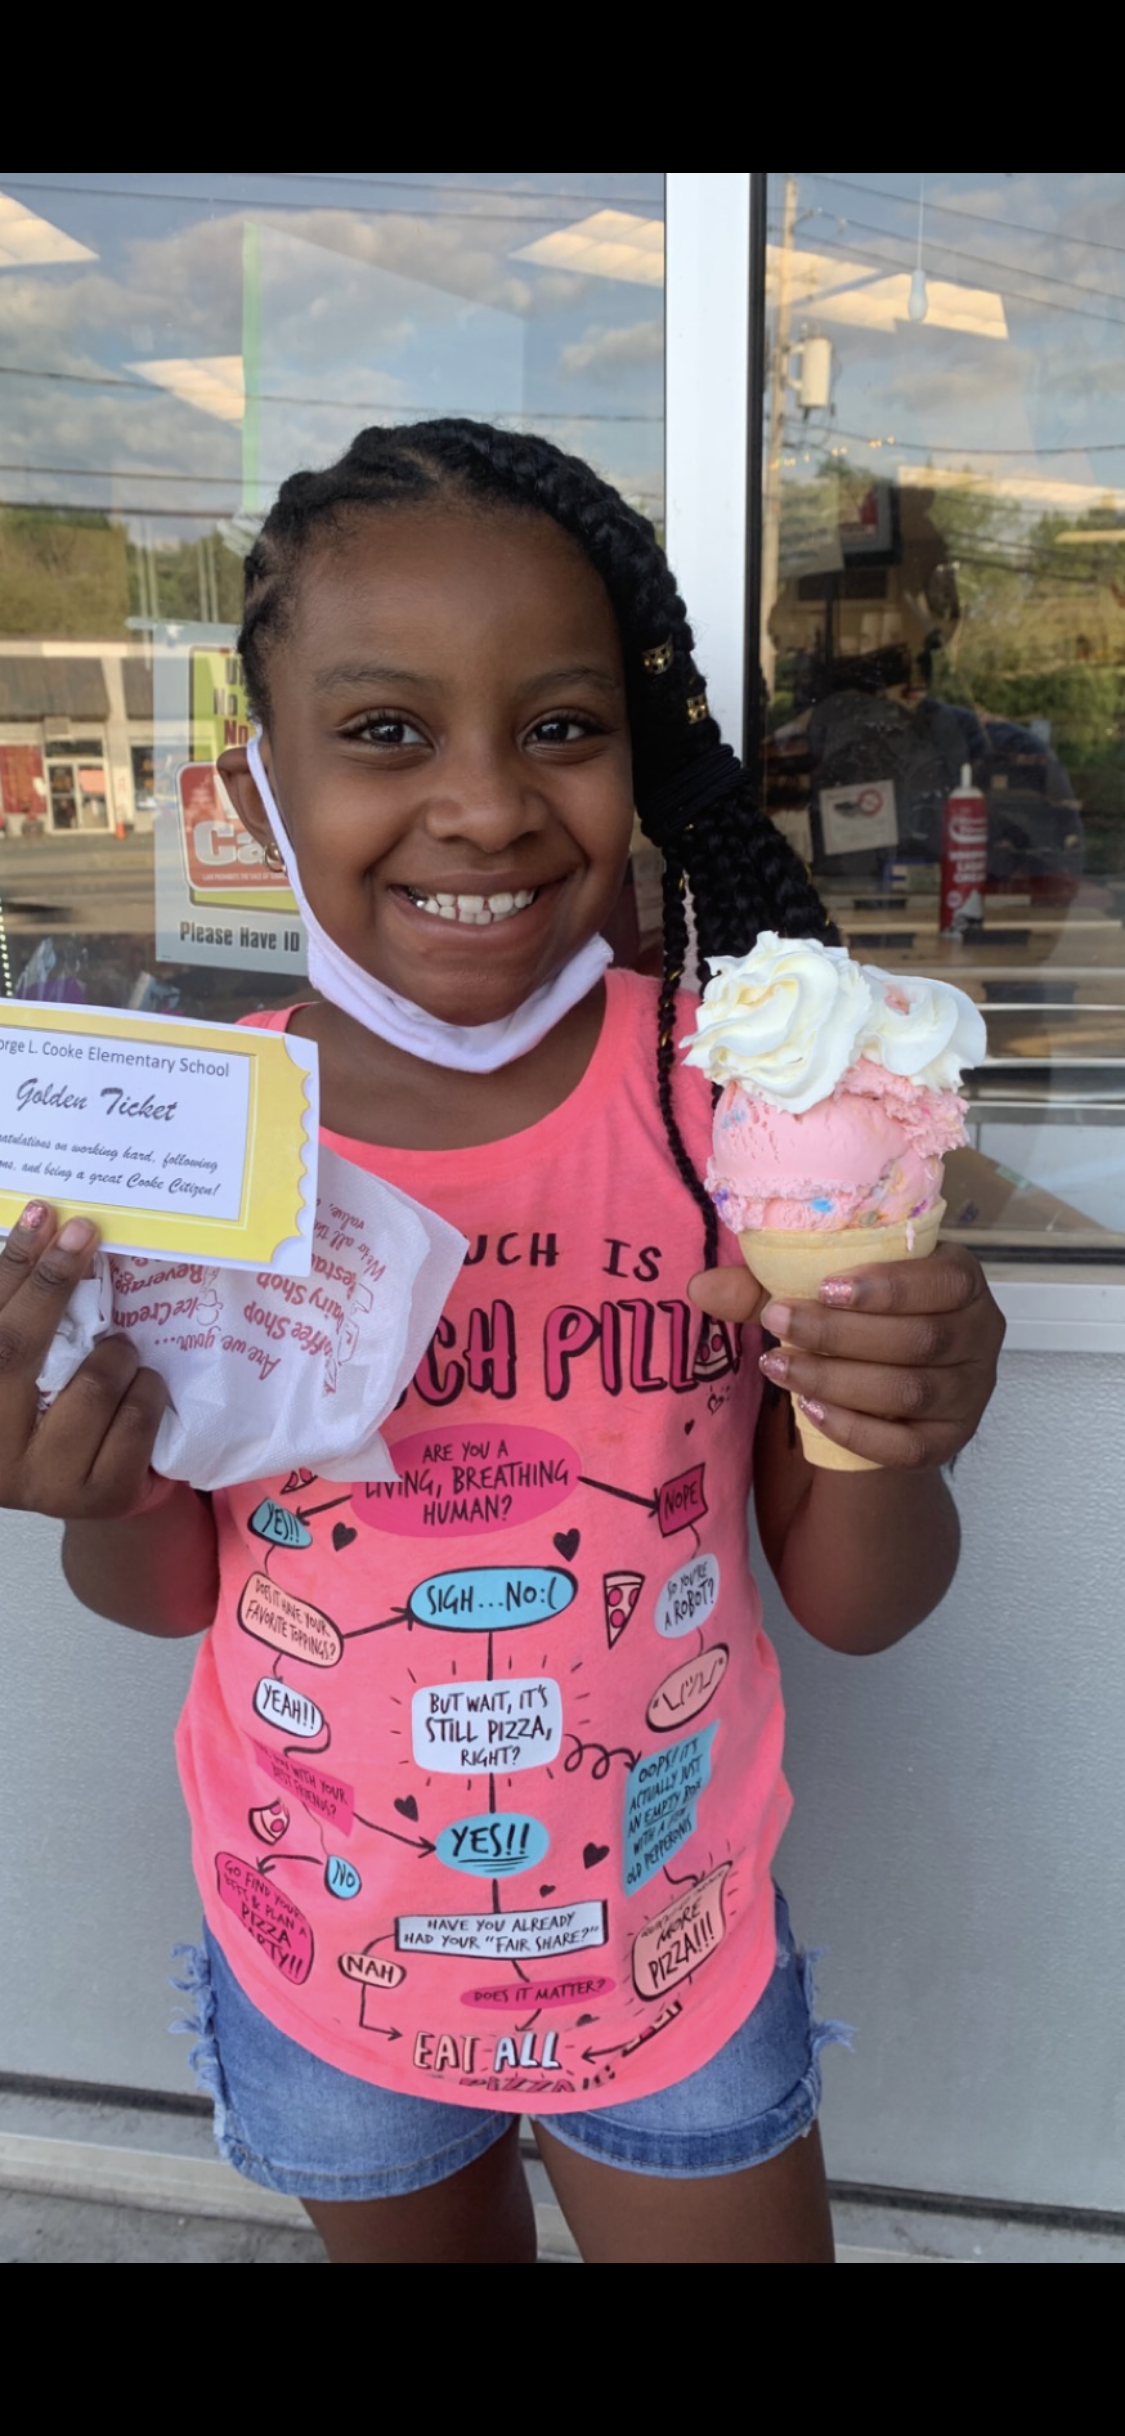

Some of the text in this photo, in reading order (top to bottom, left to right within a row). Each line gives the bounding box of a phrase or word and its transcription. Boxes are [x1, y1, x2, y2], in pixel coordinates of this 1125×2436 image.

[180, 921, 300, 952] Please Have ID
[29, 1039, 38, 1054] L.
[42, 1040, 83, 1059] Cooke
[88, 1046, 175, 1074] Elementary
[179, 1057, 230, 1077] School
[16, 1077, 178, 1121] Golden Ticket
[54, 1139, 68, 1150] on
[71, 1142, 118, 1161] working
[162, 1152, 219, 1174] following
[22, 1161, 43, 1174] and
[44, 1161, 73, 1181] being
[76, 1170, 85, 1180] a
[89, 1171, 123, 1185] great
[126, 1172, 164, 1190] Cooke
[168, 1177, 221, 1198] Citizen!
[329, 1203, 365, 1231] value,
[330, 1230, 354, 1251] all
[602, 1238, 662, 1282] IS
[257, 1272, 307, 1305] Shop
[243, 1300, 291, 1340] Shop
[221, 1335, 247, 1353] we
[394, 1299, 516, 1410] CH
[247, 1346, 281, 1381] Are
[422, 1438, 509, 1464] ARE YOU A
[452, 1458, 568, 1495] BREATHING
[422, 1494, 512, 1527] HUMAN?
[663, 1480, 698, 1521] NOPE
[260, 1501, 300, 1544] YES!!
[245, 1599, 288, 1638] FAVORITE
[255, 1577, 331, 1637] DOES IT HAVE YOUR
[664, 1577, 714, 1631] A ROBOT?
[262, 1682, 317, 1730] YEAH!!
[429, 1684, 548, 1715] BUT WAIT, IT'S
[425, 1715, 552, 1744] STILL PIZZA,
[460, 1745, 521, 1768] RIGHT?
[638, 1746, 679, 1783] OOPS!
[320, 1779, 348, 1806] YOUR
[629, 1754, 702, 1814] ACTUALLY JUST
[627, 1813, 642, 1838] AN
[643, 1789, 682, 1825] EMPTY
[450, 1822, 530, 1857] YES!!
[224, 1859, 300, 1918] GO FIND YOUR
[332, 1861, 355, 1888] NO
[627, 1862, 642, 1885] OLD
[241, 1900, 292, 1949] PIZZA
[266, 1904, 295, 1930] PLAN
[427, 1911, 575, 1932] HAVE YOU ALREADY
[404, 1932, 434, 1945] HAD
[441, 1934, 480, 1950] YOUR
[648, 1910, 715, 1990] PIZZA!!!
[347, 1956, 395, 1985] NAH
[473, 1978, 606, 2003] DOES IT MATTER?
[413, 2030, 563, 2074] EAT ALL
